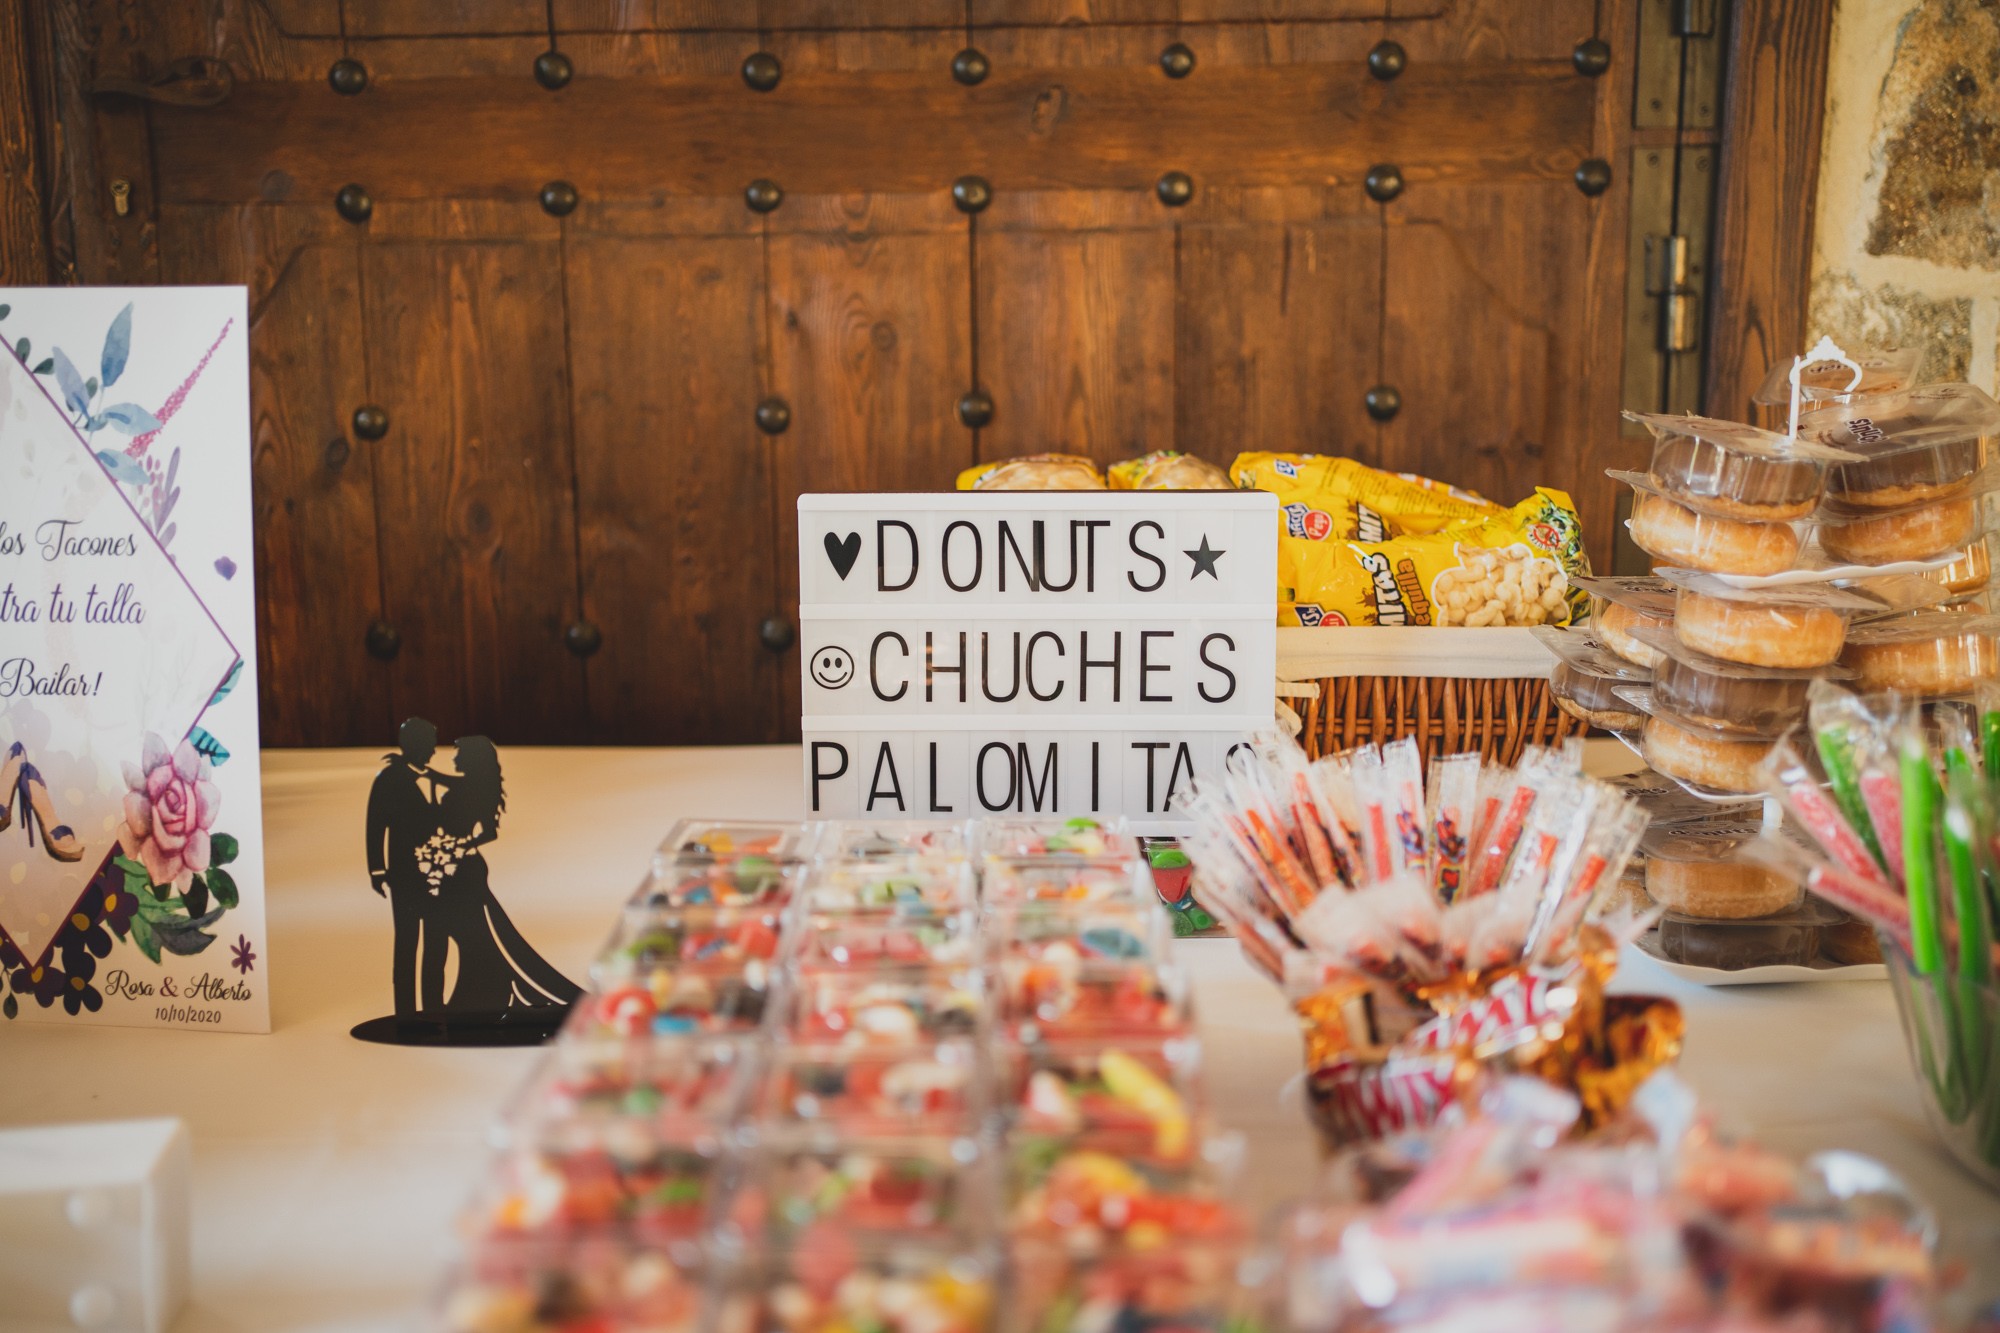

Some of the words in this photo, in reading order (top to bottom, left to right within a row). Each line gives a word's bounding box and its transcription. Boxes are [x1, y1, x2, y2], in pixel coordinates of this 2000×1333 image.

[35, 519, 138, 562] Tacones
[876, 519, 1167, 592] DONUTS
[50, 583, 77, 623] tu
[85, 583, 146, 624] talla
[0, 657, 102, 698] Bailar!
[869, 630, 1237, 703] CHUCHES
[105, 969, 155, 1001] Rosa
[159, 976, 179, 998] &
[184, 972, 252, 1002] Alberto
[155, 1003, 222, 1024] 10/10/2020
